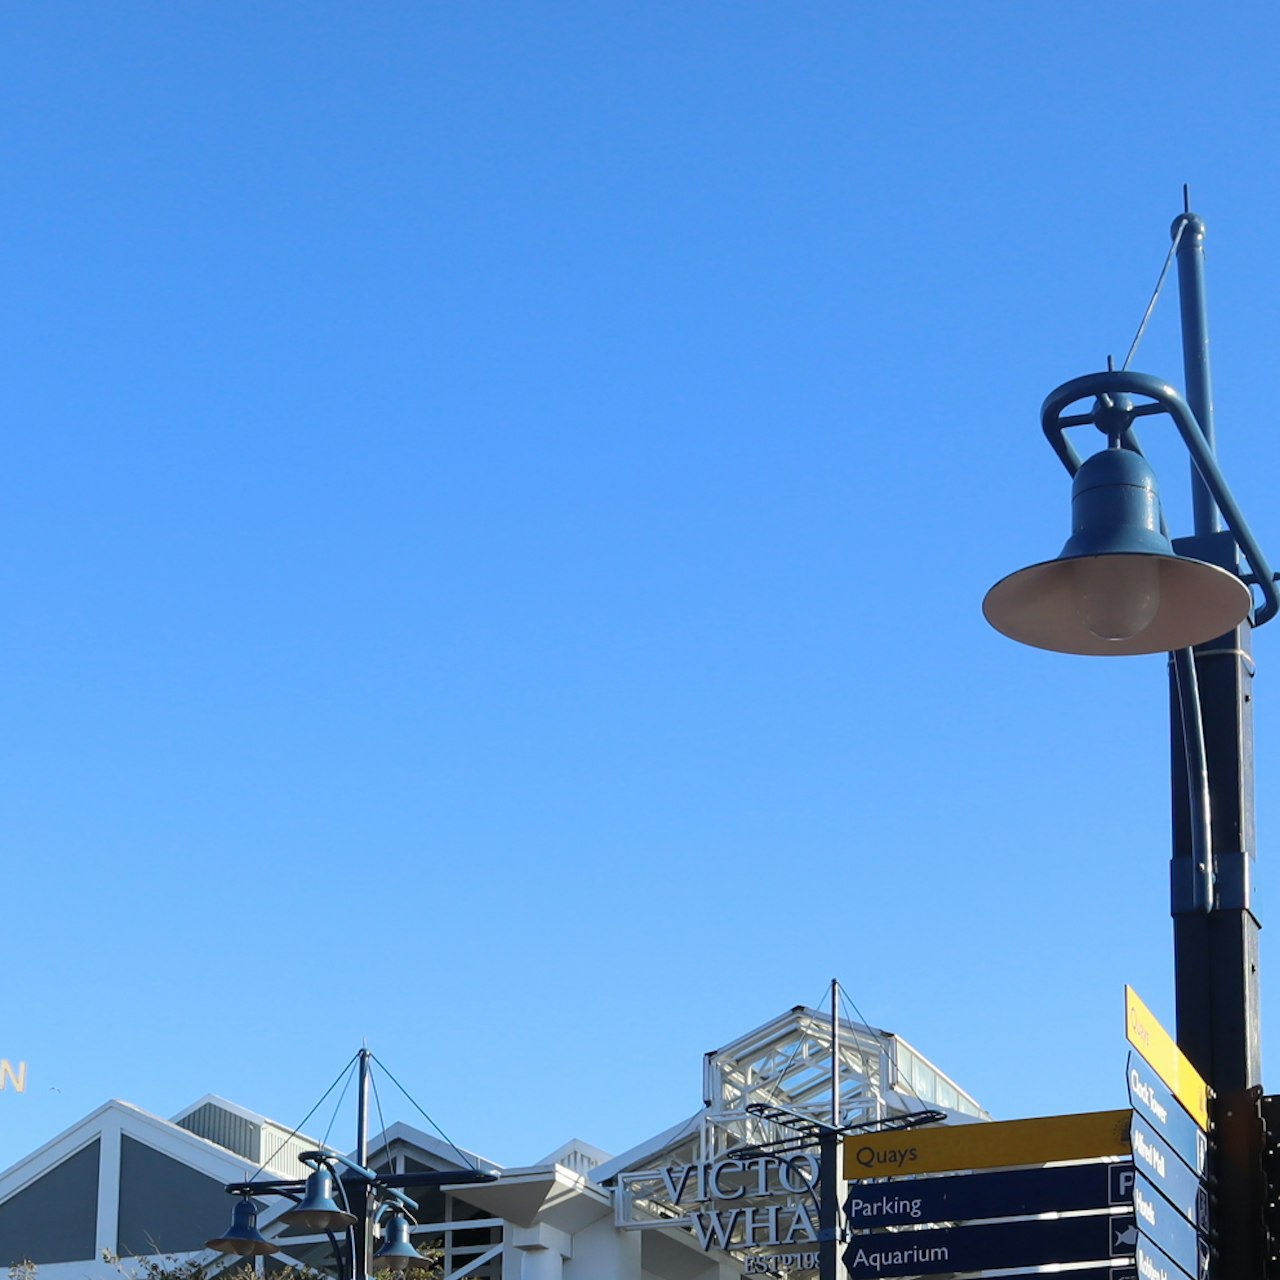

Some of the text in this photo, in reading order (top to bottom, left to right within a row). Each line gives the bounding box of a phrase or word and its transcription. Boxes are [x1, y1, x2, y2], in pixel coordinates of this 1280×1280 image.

[0, 1059, 26, 1093] N
[1149, 1087, 1168, 1125] Tower
[856, 1144, 918, 1168] Quays
[1153, 1146, 1166, 1178] Mall
[659, 1152, 820, 1205] VICTO
[851, 1195, 923, 1219] Parking
[688, 1202, 819, 1252] WHA
[853, 1244, 949, 1271] Aquarium
